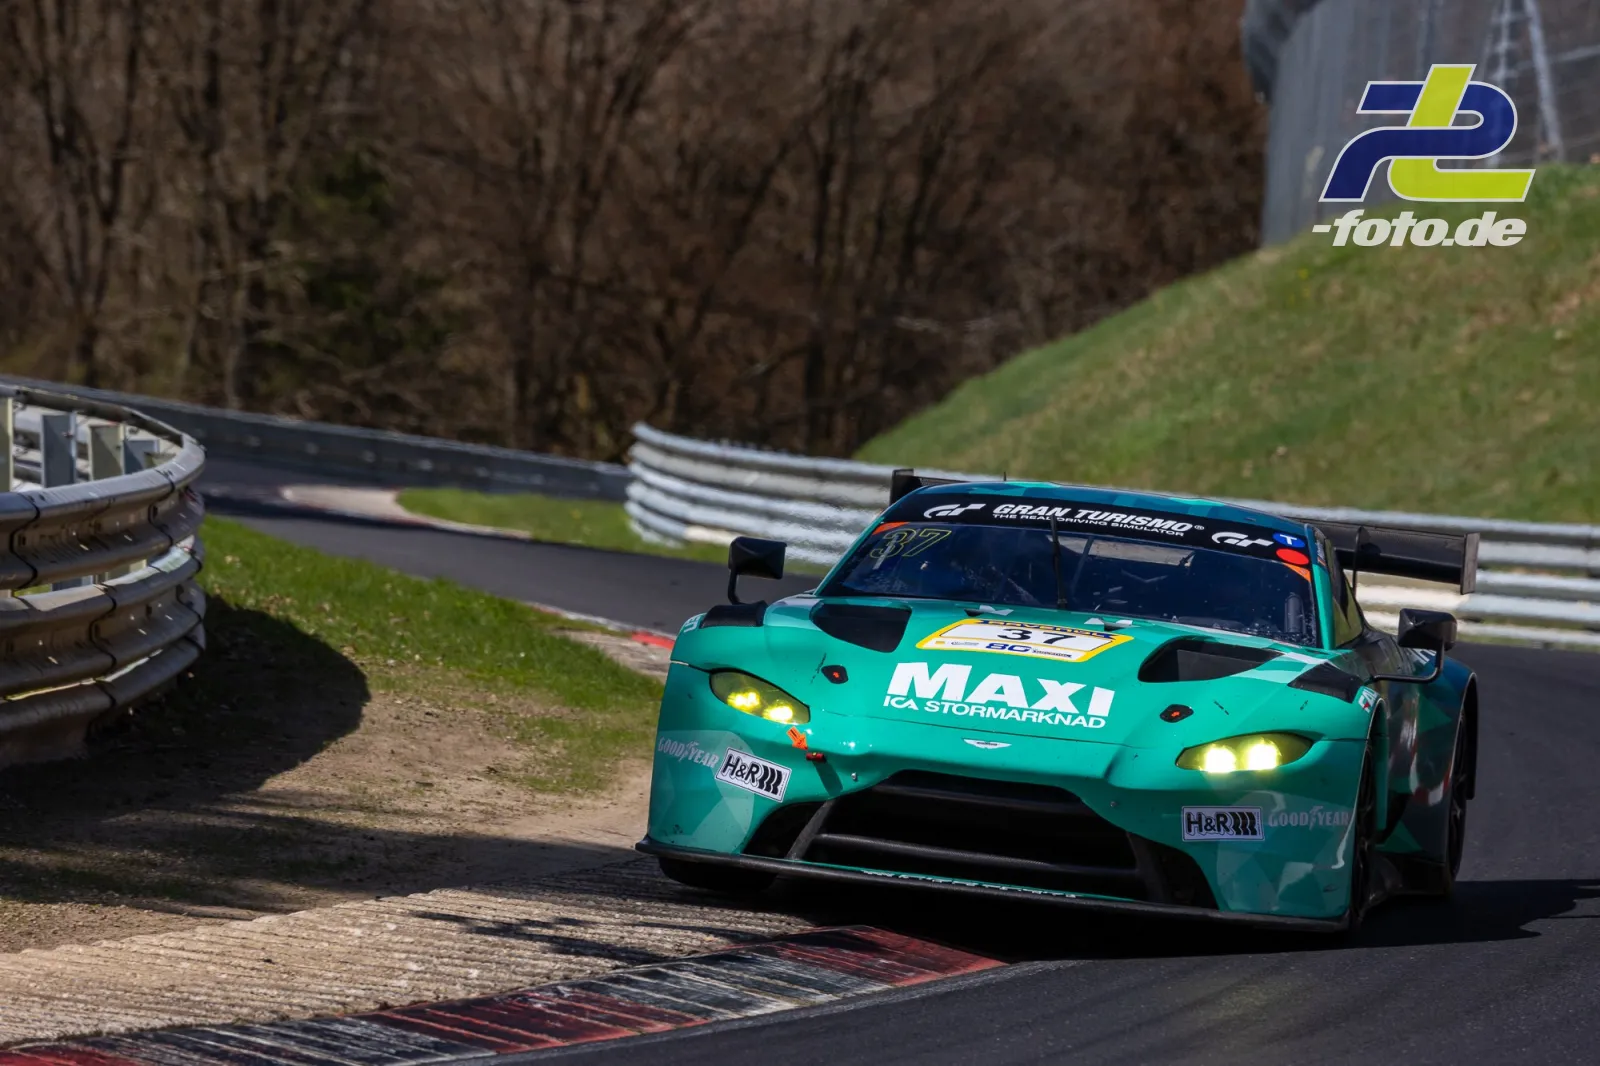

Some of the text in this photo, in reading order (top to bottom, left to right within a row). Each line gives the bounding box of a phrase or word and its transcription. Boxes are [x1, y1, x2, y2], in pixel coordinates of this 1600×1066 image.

[992, 503, 1071, 518] GRAN
[1056, 517, 1108, 527] DRIVING
[1110, 522, 1185, 537] SIMULATOR
[1279, 533, 1298, 546] T
[869, 528, 952, 559] 37
[997, 628, 1077, 645] 37
[886, 662, 1115, 717] MAXI
[883, 695, 1106, 729] ICA STORMARKNAD
[721, 753, 761, 785] H&R
[1186, 810, 1231, 835] H&R
